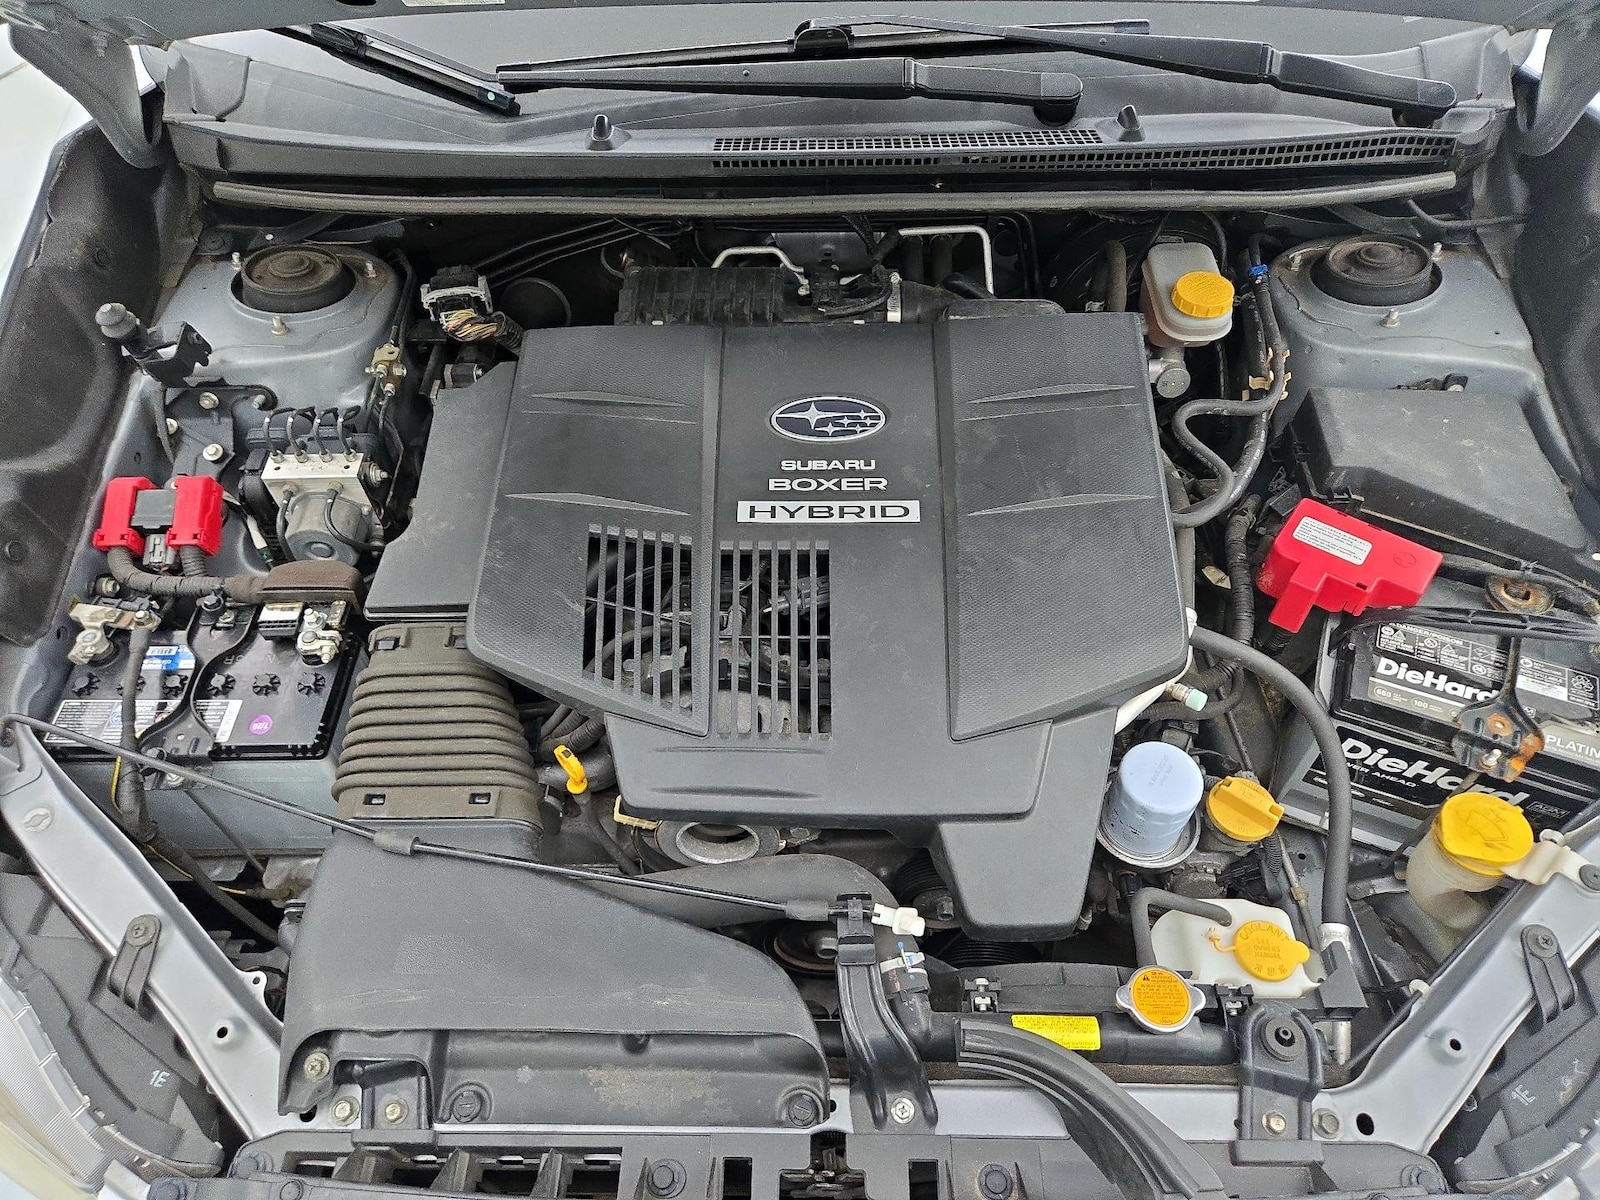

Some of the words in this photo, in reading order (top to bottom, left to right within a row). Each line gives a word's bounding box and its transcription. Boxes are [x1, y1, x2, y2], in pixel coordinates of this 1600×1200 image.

[781, 459, 876, 471] SUBARU
[768, 477, 888, 491] BOXER
[749, 505, 910, 519] HYBRID
[1376, 657, 1501, 702] DieHard
[1413, 699, 1429, 709] 100
[1239, 923, 1290, 942] COOLANT
[150, 1070, 171, 1087] 1E
[1511, 1084, 1537, 1106] 1E
